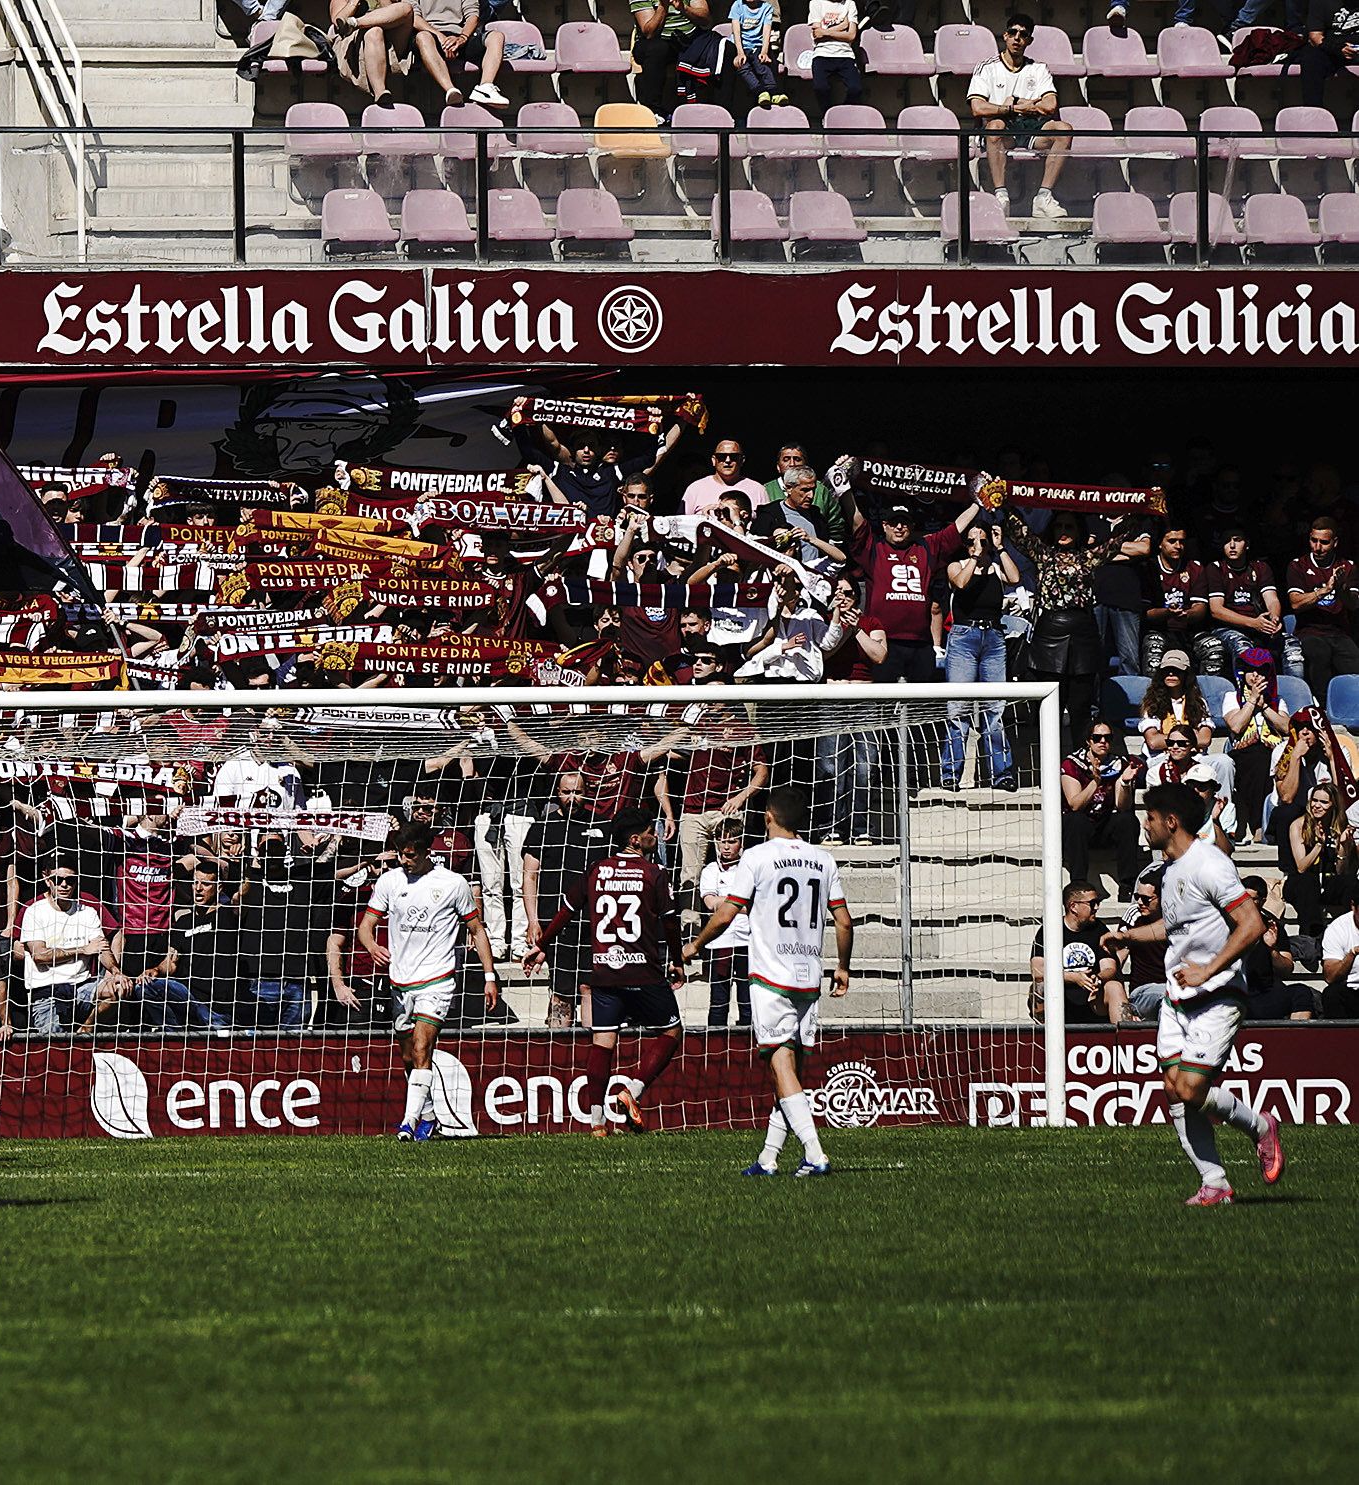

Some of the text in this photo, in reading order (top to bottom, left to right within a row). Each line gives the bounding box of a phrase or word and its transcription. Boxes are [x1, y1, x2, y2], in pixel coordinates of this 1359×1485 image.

[37, 280, 314, 355] Estrella
[328, 281, 580, 355] Galicia
[830, 282, 1101, 356] Estrella
[390, 470, 483, 493] PONTEVEDRA
[863, 460, 967, 486] PONTEVEDRA
[1038, 487, 1076, 501] PARAR
[432, 498, 499, 524] BOA
[503, 502, 578, 527] VILA
[261, 577, 293, 587] CLUB
[300, 578, 316, 587] DE
[379, 578, 481, 591] PONTEVEDRA
[370, 590, 493, 608] NUNCA SE RINDE
[217, 609, 313, 627] PONTEVEDRA
[377, 646, 481, 659] PONTEVEDRA
[364, 659, 492, 675] NUNCA SE RINDE
[604, 880, 644, 892] MONTORO
[777, 876, 822, 929] 21
[595, 894, 642, 943] 23
[1068, 1043, 1263, 1075] CONSAS
[166, 1078, 322, 1129] ence
